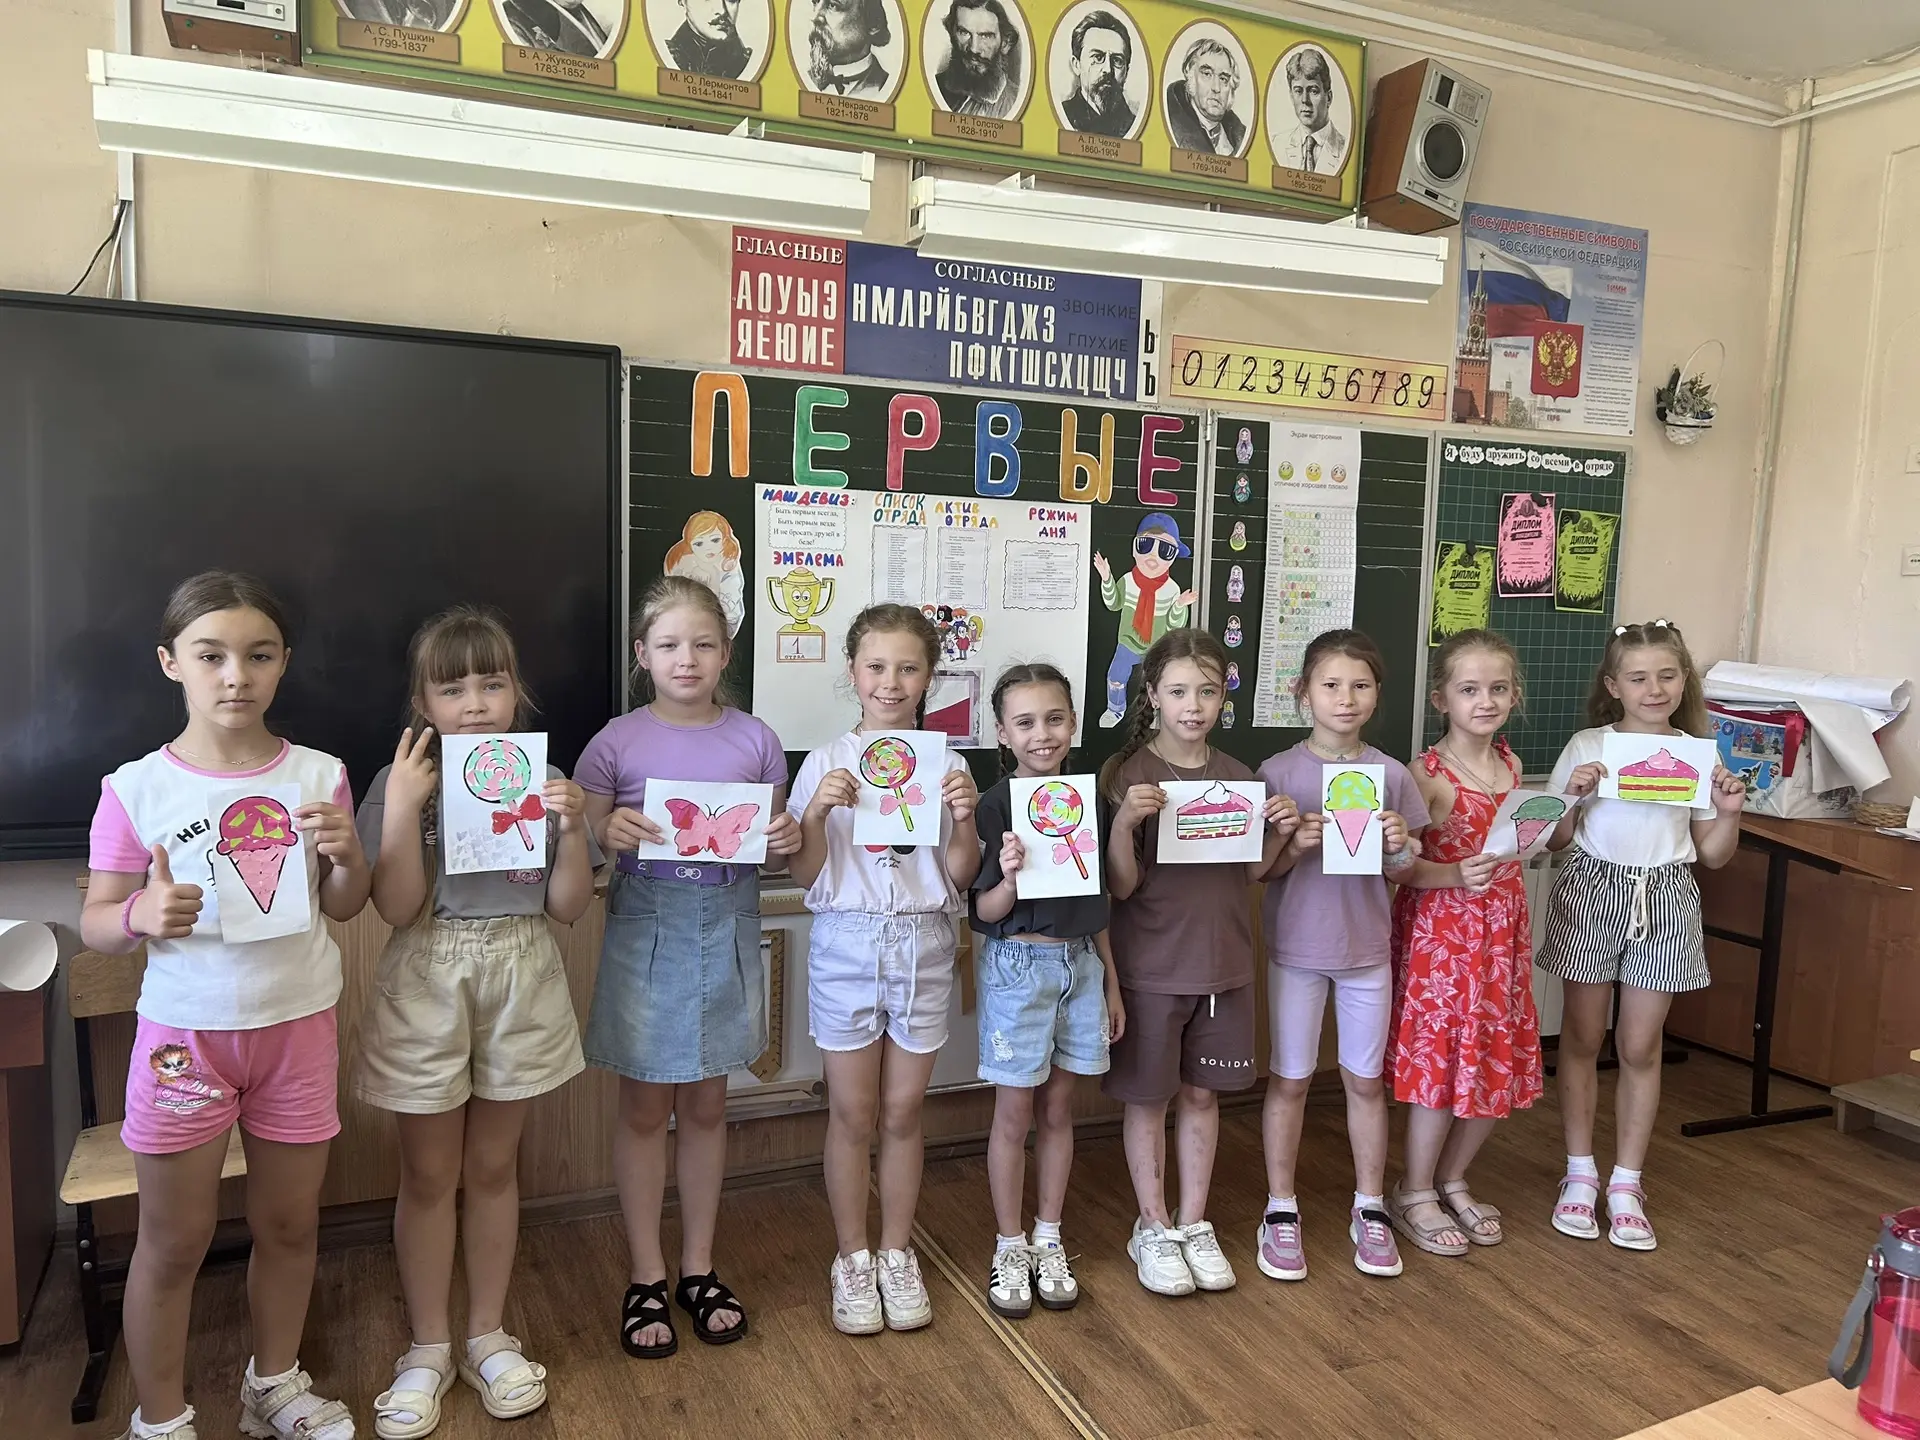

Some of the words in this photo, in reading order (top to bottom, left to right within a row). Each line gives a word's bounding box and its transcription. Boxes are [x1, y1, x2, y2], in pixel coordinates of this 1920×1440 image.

[364, 25, 374, 35] А.
[378, 26, 390, 37] С.
[393, 29, 435, 43] Пушкин
[372, 37, 427, 52] 1799-1837
[519, 49, 529, 59] В.
[532, 52, 543, 61] А.
[545, 53, 599, 70] Жуковский
[534, 63, 585, 78] 1783-1852
[669, 73, 680, 82] М.
[683, 75, 696, 84] Ю.
[699, 77, 749, 93] Лермонтов
[687, 86, 732, 100] 1814-1841
[815, 95, 824, 104] Н.
[827, 97, 835, 106] А.
[838, 100, 879, 113] Некрасов
[825, 107, 868, 121] 1821-1878
[949, 114, 958, 123] Л.
[960, 116, 969, 125] Н.
[972, 118, 1004, 130] Толстой
[956, 125, 998, 139] 1828-1910
[1098, 137, 1121, 148] Чехов
[1081, 144, 1119, 157] 1860-1904
[1192, 162, 1227, 174] 1769-1844
[1205, 155, 1232, 167] Крылов
[1469, 213, 1585, 242] ГОСУДАРСТВЕННЫЕ
[1587, 231, 1642, 253] СИМВОЛЫ
[735, 235, 844, 265] ГЛАСНЫЕ
[1499, 239, 1576, 261] РОССИЙСКОЙ
[1578, 250, 1641, 271] ФЕДЕРАЦИИ
[934, 261, 1056, 292] СОГЛАСНЫЕ
[1062, 299, 1137, 320] ЗВОНКИЕ
[690, 371, 1184, 506] ПЕРВЫЕ
[1290, 430, 1308, 440] Экран
[1309, 433, 1343, 441] настроения
[1446, 447, 1453, 458] Я
[1461, 448, 1482, 462] буду
[1487, 450, 1525, 463] дружить
[1530, 455, 1540, 463] со
[1544, 458, 1570, 467] всеми
[1585, 462, 1613, 472] отряде
[762, 488, 798, 503] НАШ
[796, 490, 855, 506] ДЕВИЗ:
[874, 492, 926, 511] СПИСОК
[934, 501, 980, 514] АКТИВ
[873, 508, 927, 526] ОТРЯДА
[945, 514, 999, 528] ОТРЯДА
[1038, 526, 1067, 539] ДНЯ
[1511, 519, 1542, 532] ДИПЛОМ
[789, 529, 813, 537] бросать
[814, 530, 835, 538] друзей
[1570, 535, 1599, 545] ДИПЛОМ
[1450, 569, 1481, 580] ДИПЛОМ
